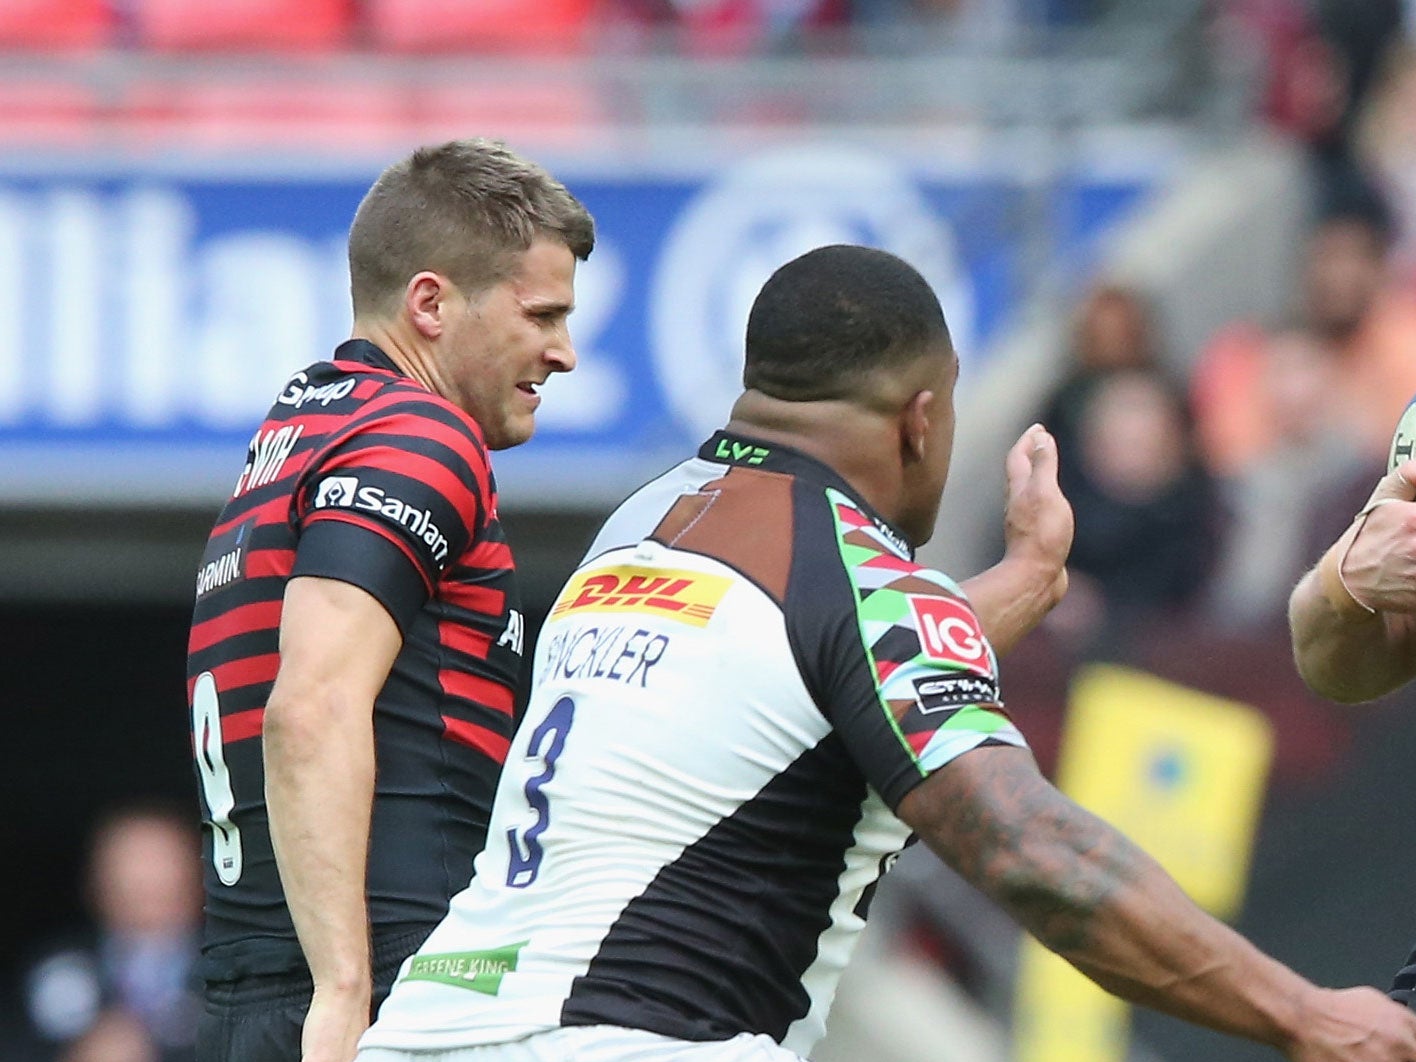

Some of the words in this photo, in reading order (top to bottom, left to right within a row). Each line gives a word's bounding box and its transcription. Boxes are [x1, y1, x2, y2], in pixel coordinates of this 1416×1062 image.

[570, 574, 694, 610] DHL
[922, 613, 982, 660] IG
[505, 695, 576, 888] 3
